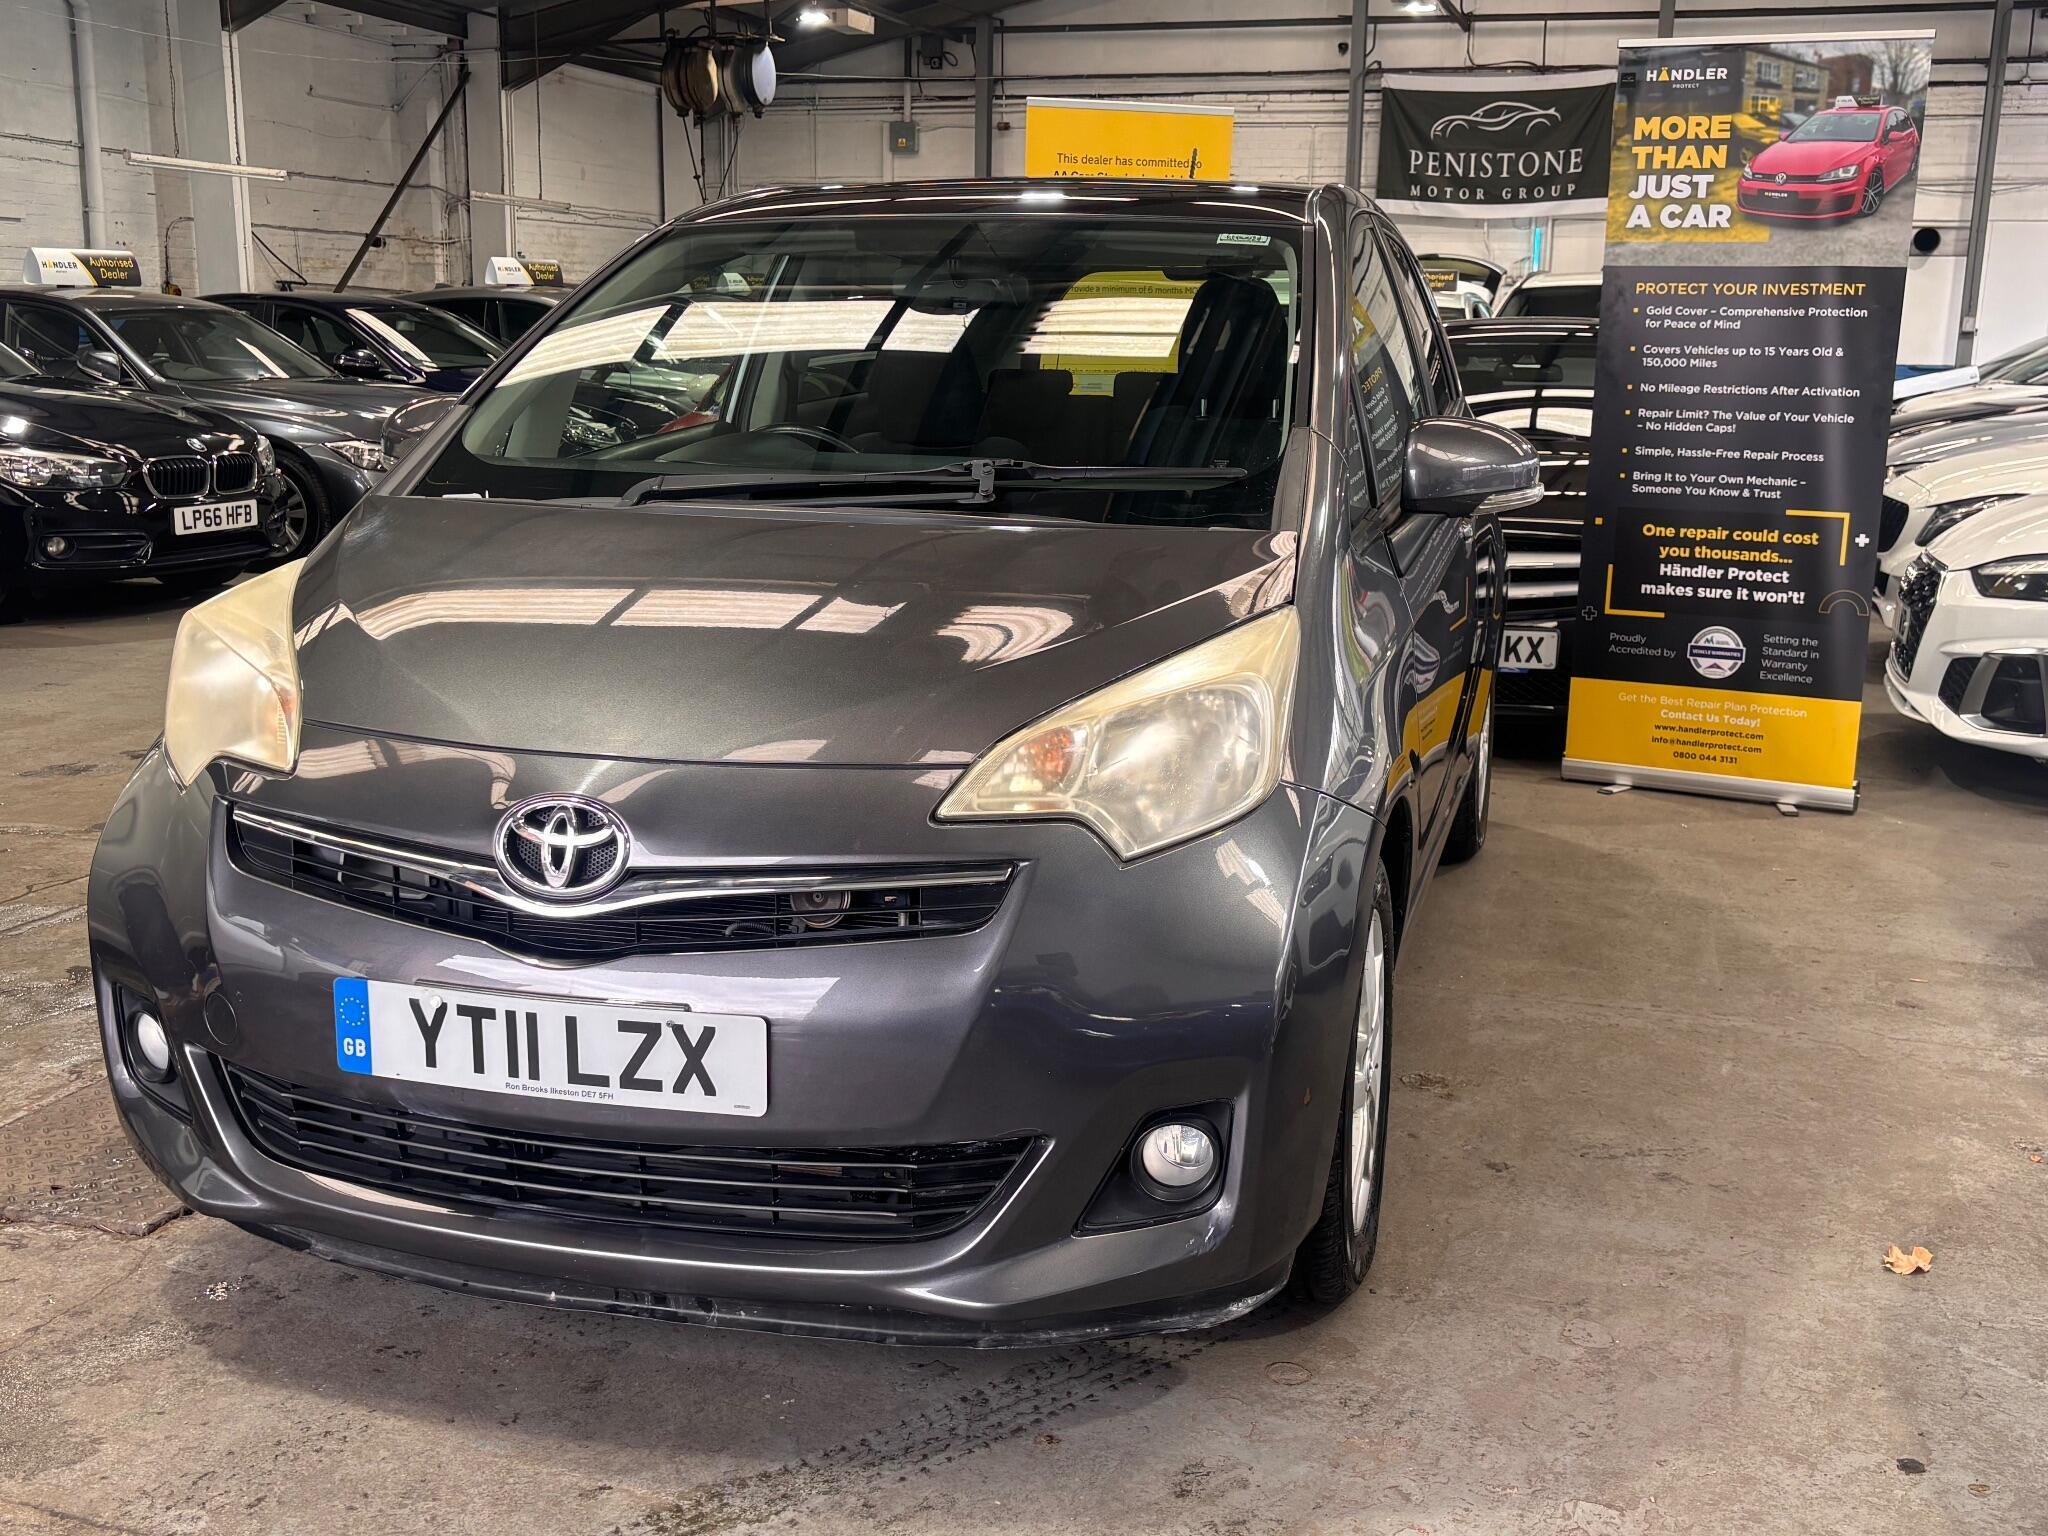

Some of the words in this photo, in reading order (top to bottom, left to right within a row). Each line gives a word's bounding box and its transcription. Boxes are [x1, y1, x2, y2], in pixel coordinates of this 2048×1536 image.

[1633, 114, 1732, 141] MORE
[1057, 153, 1078, 164] This
[1082, 155, 1112, 165] dealer
[1116, 156, 1133, 166] has
[1136, 158, 1190, 168] committed
[1409, 147, 1583, 178] PENISTONE
[1632, 144, 1728, 169] THAN
[1410, 185, 1484, 200] MOTOR
[1502, 183, 1576, 200] GROUP
[1629, 174, 1714, 199] JUST
[1625, 205, 1651, 229] A
[1659, 204, 1731, 229] CAR
[90, 257, 133, 268] Authorised
[100, 268, 128, 279] Dealer
[536, 272, 554, 280] Dealer
[1139, 285, 1146, 293] of
[1636, 282, 1708, 295] PROTECT
[1712, 283, 1758, 296] YOUR
[1762, 284, 1866, 296] INVESTMENT
[1646, 306, 1673, 317] Gold
[1675, 307, 1708, 318] Cover
[1720, 307, 1805, 319] Comprehensive
[1809, 308, 1868, 318] Protection
[1645, 319, 1661, 329] for
[1663, 319, 1697, 329] Peace
[1699, 319, 1711, 329] of
[1713, 320, 1741, 330] Mind
[1643, 345, 1680, 355] Covers
[1684, 346, 1729, 356] Vehicles
[1732, 349, 1746, 359] up
[1749, 347, 1761, 356] to
[1765, 346, 1776, 356] 15
[1778, 347, 1809, 357] Years
[1812, 347, 1832, 357] Old
[1835, 347, 1844, 357] &
[1642, 358, 1687, 369] 150,000
[1689, 358, 1718, 368] Miles
[1640, 383, 1656, 392] No
[1658, 384, 1701, 396] Mileage
[1703, 385, 1768, 396] Restrictions
[1771, 386, 1799, 396] After
[1802, 386, 1860, 397] Activation
[1638, 409, 1673, 421] Repair
[1676, 409, 1709, 420] Limit?
[1712, 411, 1732, 421] The
[1736, 411, 1765, 421] Value
[1769, 411, 1781, 422] of
[1783, 412, 1809, 422] Your
[1812, 412, 1854, 424] Vehicle
[1646, 422, 1661, 431] No
[1664, 422, 1703, 432] Hidden
[1706, 422, 1736, 434] Caps!
[1635, 447, 1674, 459] Simple,
[1678, 448, 1740, 459] Hassle-Free
[1743, 449, 1778, 462] Repair
[1781, 451, 1824, 462] Process
[1633, 472, 1661, 484] Bring
[1663, 473, 1672, 482] It
[1675, 474, 1687, 482] to
[1689, 473, 1716, 484] Your
[1719, 475, 1744, 485] Own
[1747, 475, 1798, 487] Mechanic
[1632, 484, 1681, 495] Someone
[1684, 486, 1706, 495] You
[1709, 486, 1741, 497] Know
[1743, 488, 1751, 498] &
[1753, 488, 1781, 499] Trust
[182, 508, 222, 530] LP66
[226, 505, 252, 525] HFB
[1643, 523, 1677, 538] One
[1679, 526, 1730, 542] repair
[1733, 528, 1779, 543] could
[1782, 530, 1819, 545] cost
[1659, 547, 1691, 560] you
[1694, 545, 1793, 564] thousands...
[1659, 562, 1723, 581] Händler
[1727, 566, 1790, 583] Protect
[1641, 581, 1694, 596] makes
[1697, 586, 1733, 600] sure
[1736, 585, 1749, 600] it
[1609, 633, 1646, 644] Proudly
[1764, 634, 1799, 646] Setting
[1801, 638, 1818, 647] the
[1504, 636, 1544, 663] KX
[1609, 645, 1662, 656] Accredited
[1664, 648, 1676, 658] by
[1762, 647, 1807, 658] Standard
[1810, 651, 1819, 659] in
[1762, 659, 1808, 672] Warranty
[1760, 671, 1813, 684] Excellence
[1618, 692, 1637, 701] Get
[1640, 694, 1656, 704] the
[1660, 696, 1683, 706] Best
[1687, 698, 1720, 710] Repair
[1724, 701, 1746, 712] Plan
[1750, 704, 1807, 717] Protection
[1661, 709, 1703, 722] Contact
[1707, 713, 1719, 723] Us
[1723, 715, 1761, 727] Today!
[1654, 724, 1764, 740] www.handlerprotect.com
[1652, 737, 1762, 754] info@handlerprotect.com
[1673, 752, 1696, 760] 0800
[1699, 753, 1717, 761] 044
[1720, 756, 1737, 764] 3131
[342, 1037, 366, 1057] GB
[409, 997, 541, 1081] YT11
[564, 1015, 716, 1097] LZX
[505, 1082, 520, 1090] Ron
[522, 1084, 548, 1093] Brooks
[550, 1087, 579, 1096] Ilkeston
[581, 1090, 596, 1098] DE7
[599, 1092, 614, 1100] 5FH
